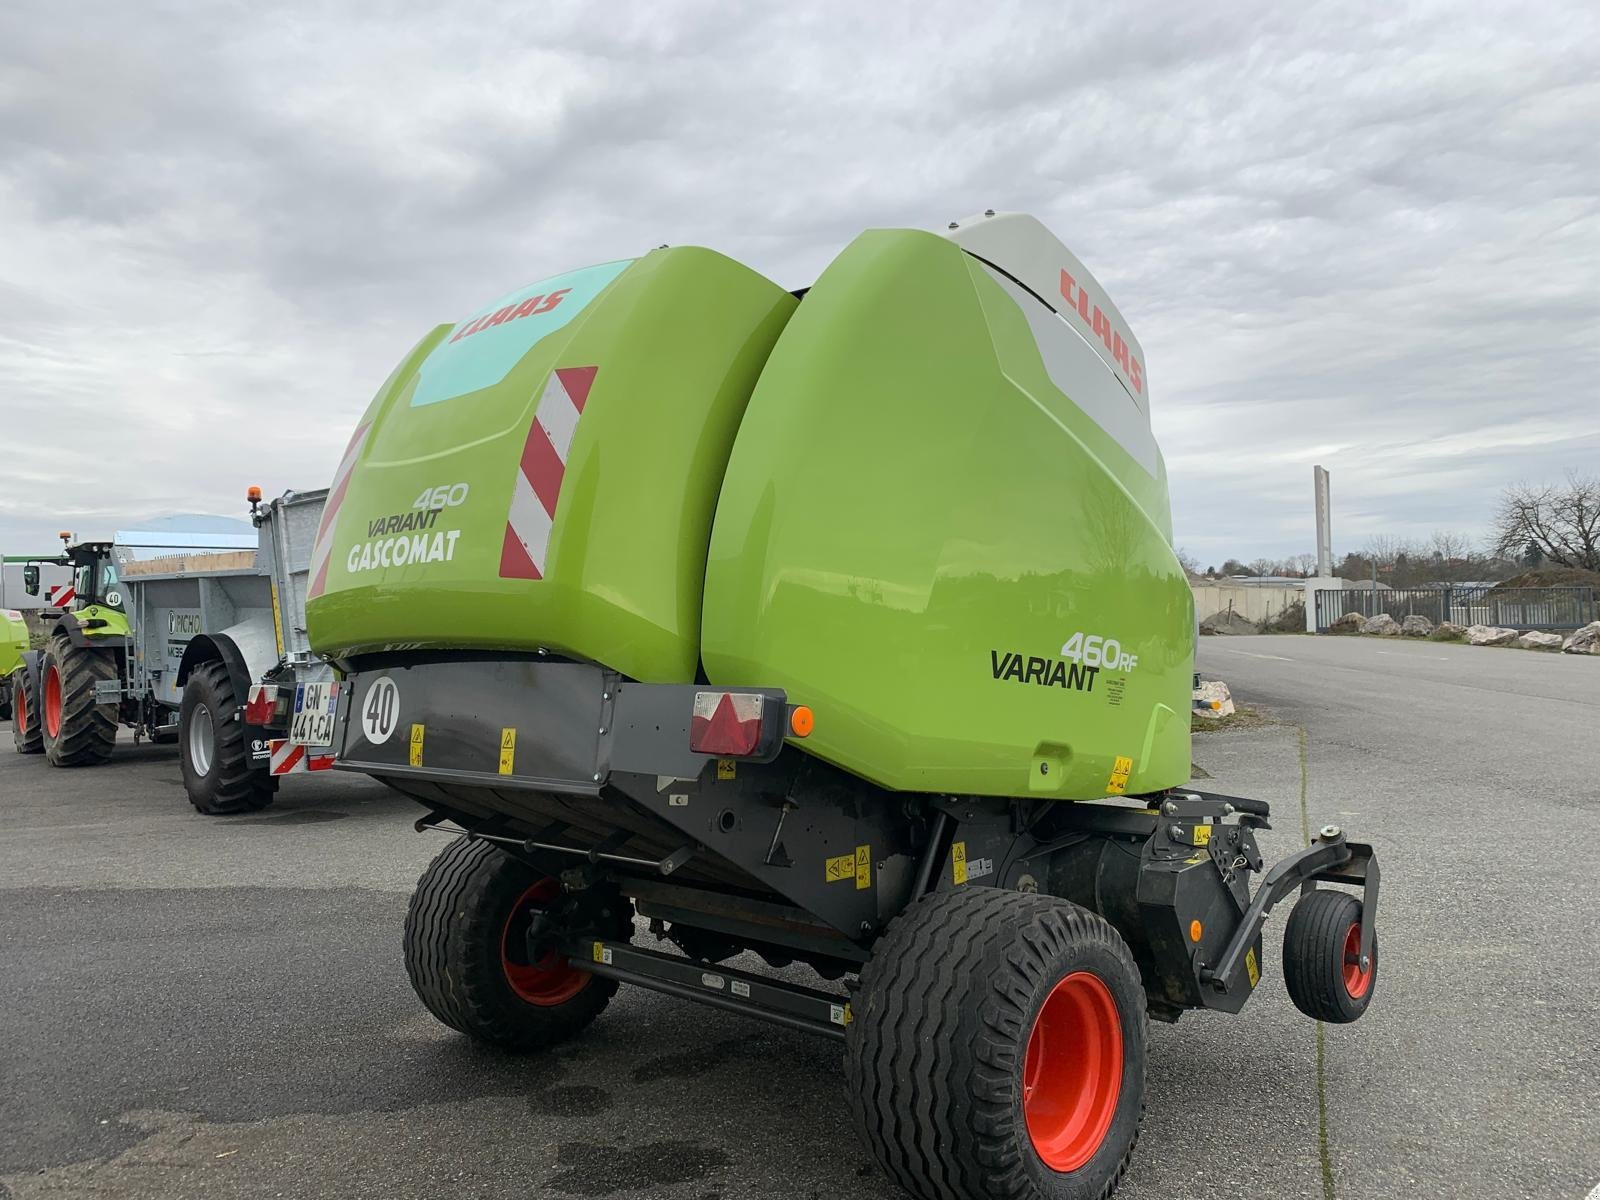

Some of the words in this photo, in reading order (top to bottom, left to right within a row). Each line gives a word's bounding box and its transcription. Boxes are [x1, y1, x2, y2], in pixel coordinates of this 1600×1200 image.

[449, 287, 573, 344] CLAAS
[1060, 268, 1142, 394] CLAAS
[412, 483, 469, 510] 460
[368, 508, 443, 538] VARIANT
[347, 530, 460, 573] GASCOMAT
[109, 594, 119, 604] 40
[991, 651, 1100, 692] VARIANT
[292, 715, 332, 741] 441-CA
[366, 683, 395, 736] 40
